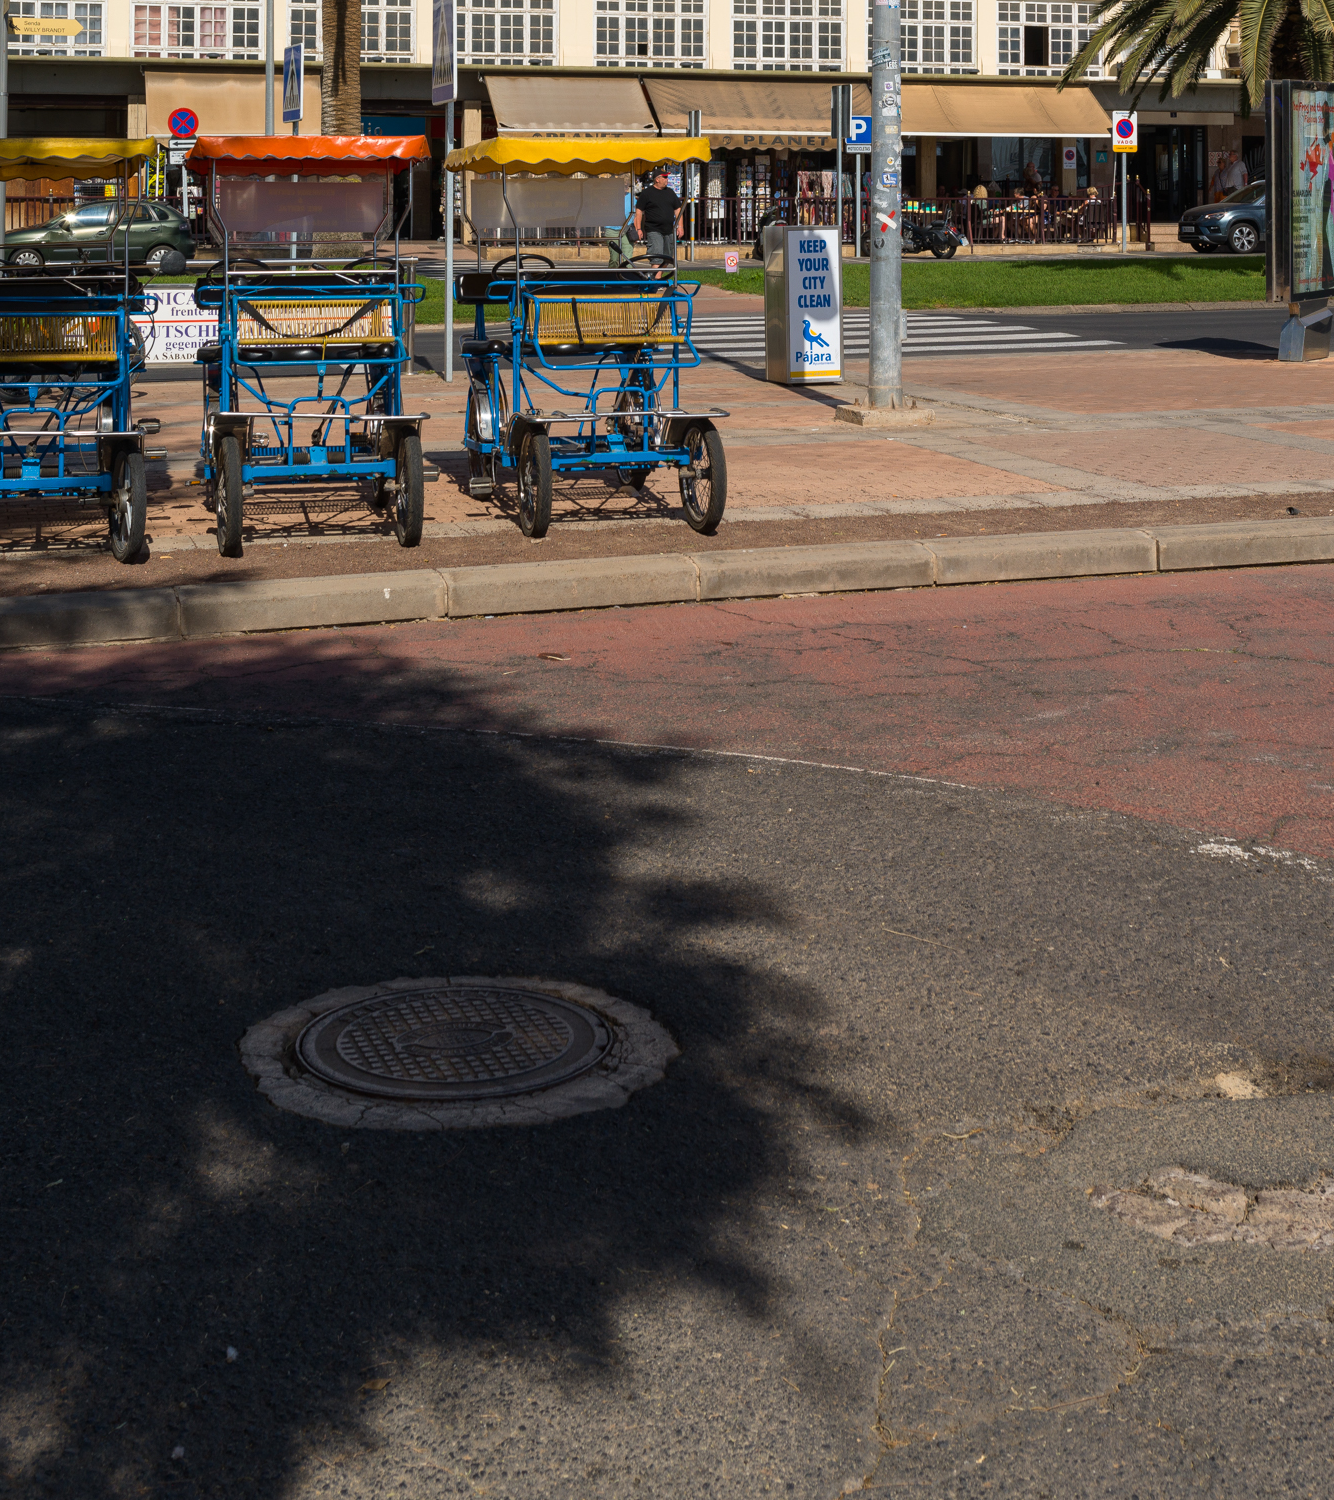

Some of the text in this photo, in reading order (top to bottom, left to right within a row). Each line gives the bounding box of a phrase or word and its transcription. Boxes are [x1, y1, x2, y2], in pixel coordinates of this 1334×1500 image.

[851, 119, 867, 141] P
[743, 135, 828, 146] PLANET
[799, 240, 827, 254] KEEP
[797, 257, 830, 272] YOUR
[802, 276, 826, 290] CITY
[797, 294, 831, 308] CLEAN
[171, 306, 204, 317] frente
[795, 351, 832, 366] Pájara
